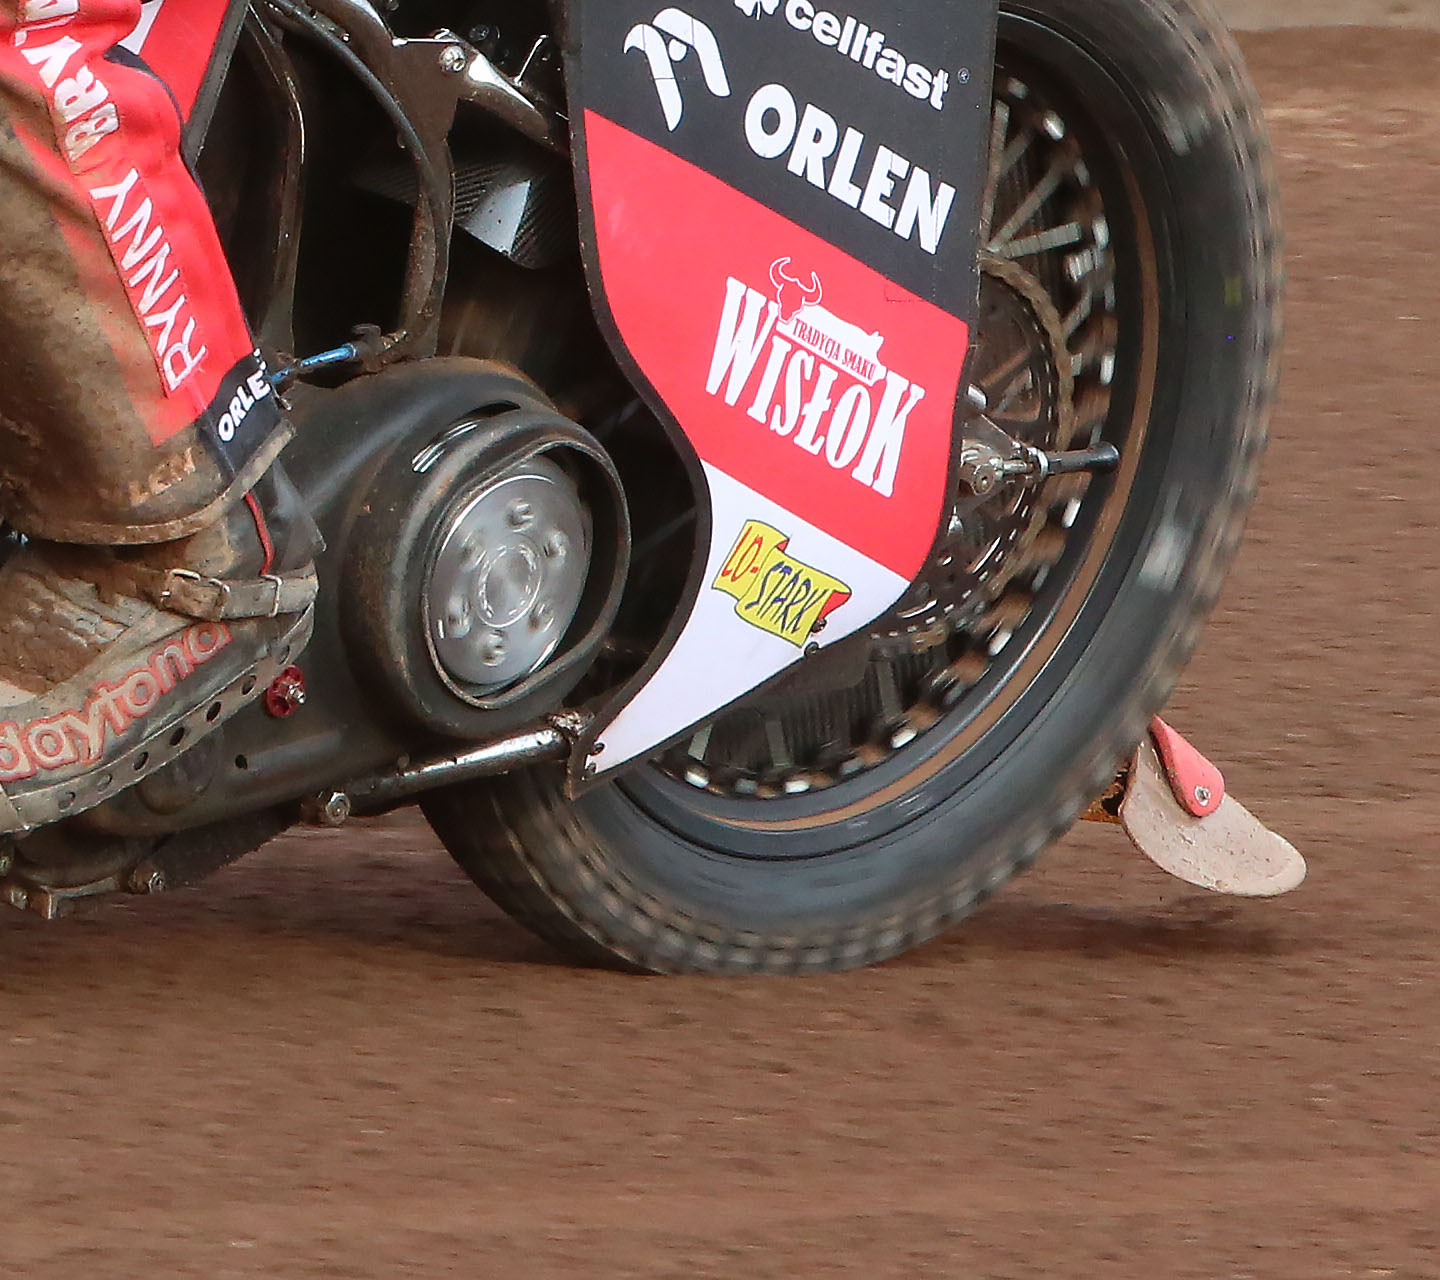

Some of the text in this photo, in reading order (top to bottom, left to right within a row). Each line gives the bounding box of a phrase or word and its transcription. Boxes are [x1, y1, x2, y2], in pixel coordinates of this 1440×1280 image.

[744, 81, 957, 258] ORLEN
[89, 167, 207, 394] RYNNY
[790, 317, 879, 382] TRADYCJA SMAKU
[705, 275, 926, 499] WISŁOK
[745, 561, 829, 635] STARK
